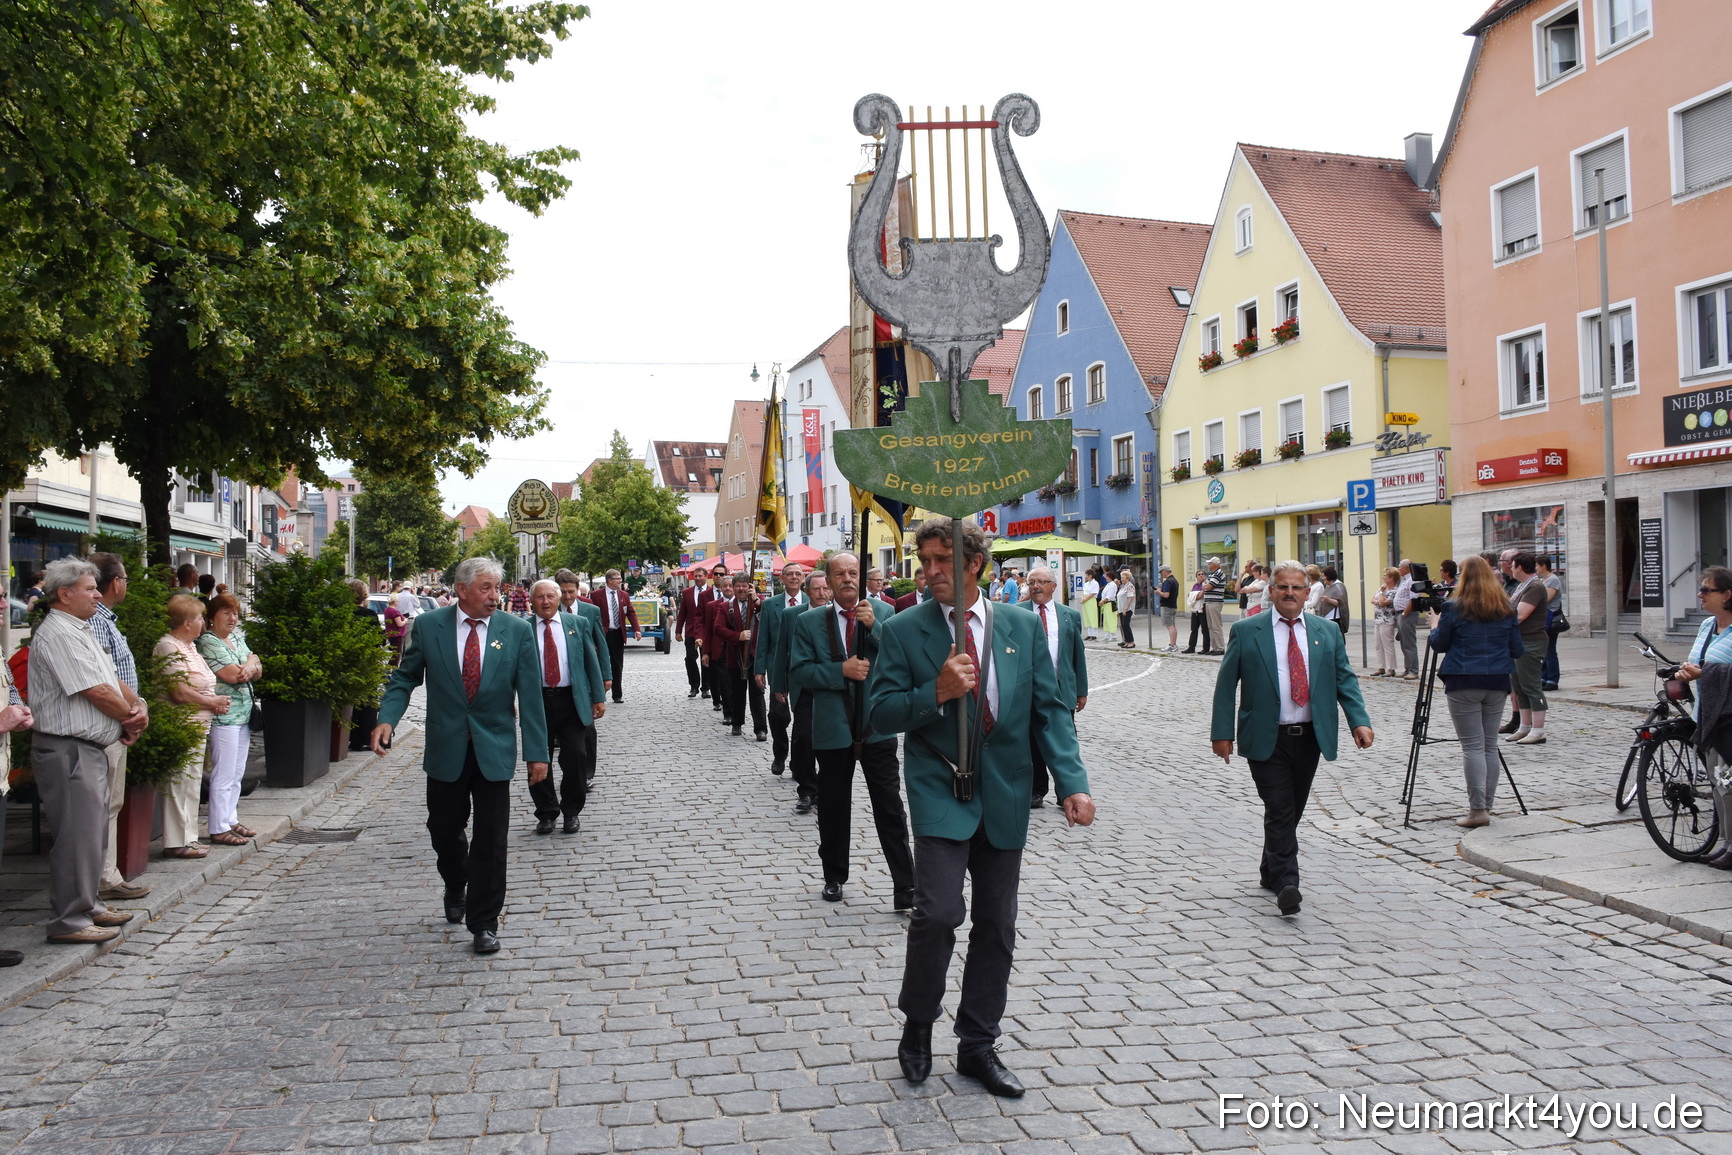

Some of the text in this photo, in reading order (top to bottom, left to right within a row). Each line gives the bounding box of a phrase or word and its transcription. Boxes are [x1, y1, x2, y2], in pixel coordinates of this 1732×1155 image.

[1672, 388, 1732, 411] NIEßLBE
[805, 412, 814, 437] K&L
[1392, 414, 1407, 422] KINO
[879, 429, 1032, 450] Gesangverein
[1680, 432, 1702, 441] OBST
[1712, 428, 1732, 437] GEM
[933, 457, 984, 474] 1927
[1519, 458, 1538, 466] Deutsch
[1544, 454, 1563, 466] DER
[1437, 450, 1446, 500] KINO
[1478, 466, 1496, 480] DER
[1519, 467, 1539, 475] Reisebü
[884, 468, 1031, 497] Breitenbrunn
[1382, 472, 1425, 487] RIALTO KINO
[1353, 484, 1369, 508] P
[280, 523, 295, 533] H&M
[1006, 516, 1055, 536] APOTHEKE
